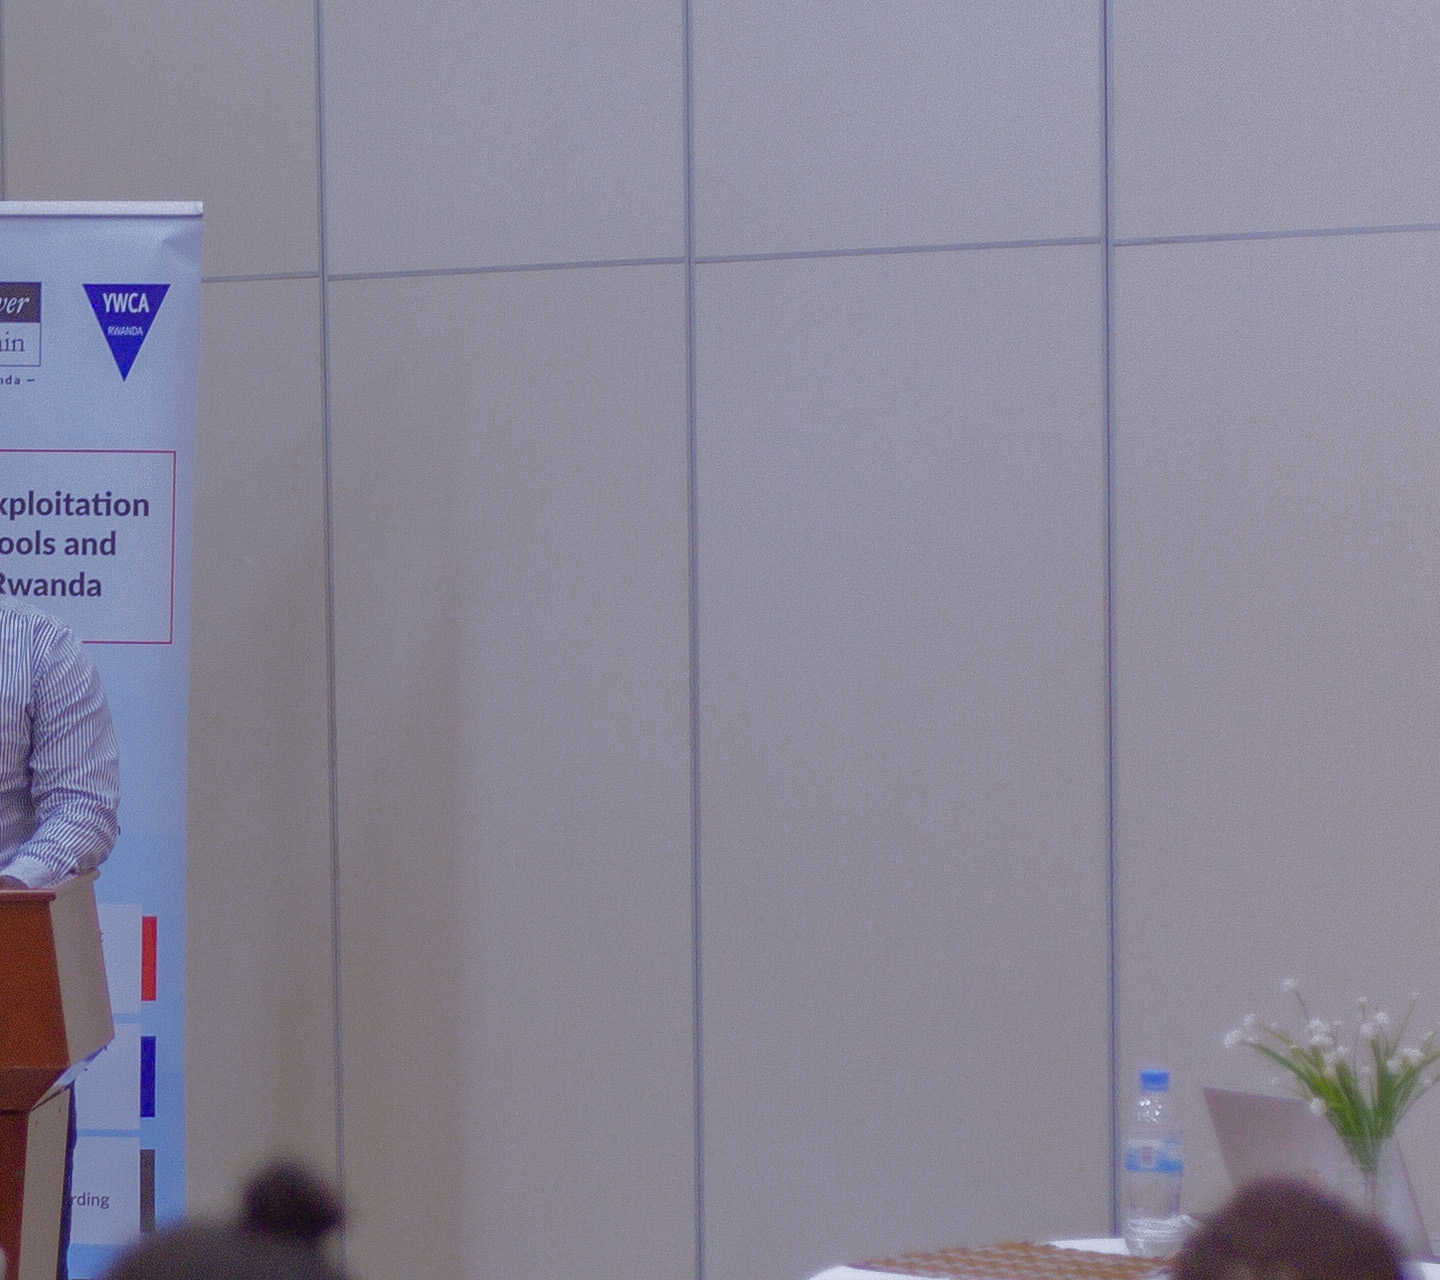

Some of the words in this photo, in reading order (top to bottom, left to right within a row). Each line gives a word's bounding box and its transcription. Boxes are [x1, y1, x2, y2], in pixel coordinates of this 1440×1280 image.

[102, 292, 150, 314] YWCA
[107, 326, 144, 336] RWANDA
[64, 530, 117, 556] and
[70, 1191, 110, 1210] rding
